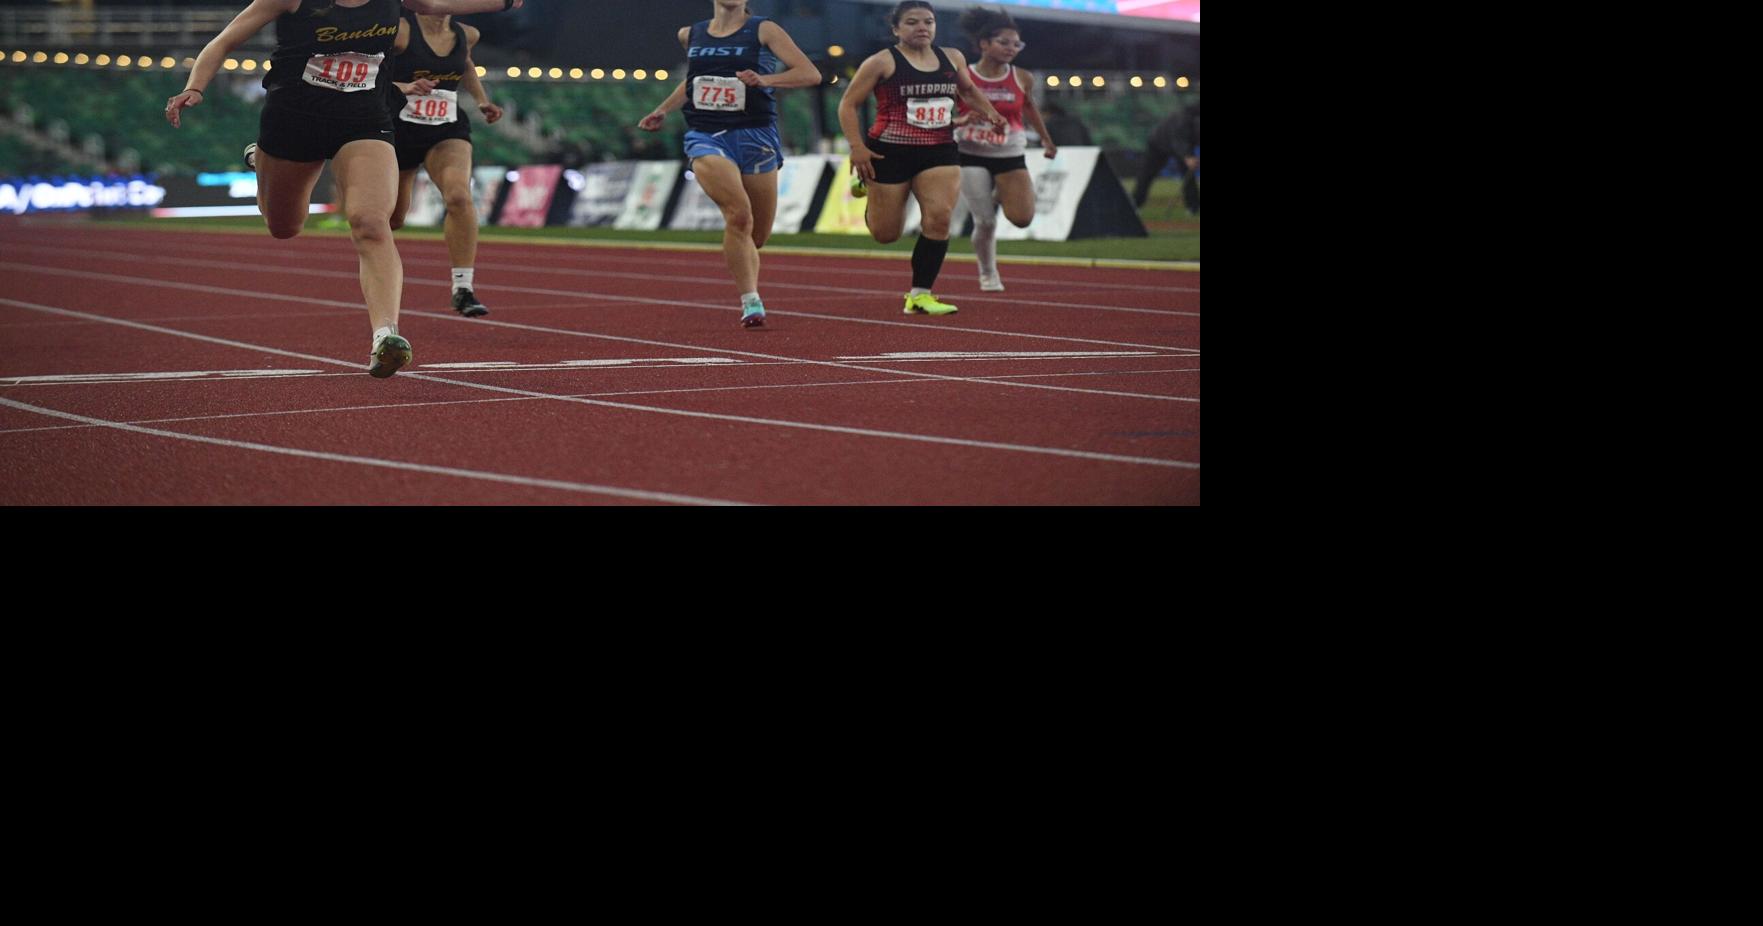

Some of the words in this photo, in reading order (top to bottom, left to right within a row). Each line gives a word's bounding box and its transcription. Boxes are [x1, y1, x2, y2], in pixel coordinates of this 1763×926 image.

[315, 24, 397, 42] Bandon
[688, 46, 747, 58] EAST
[319, 58, 368, 83] 109
[311, 75, 338, 86] TRACK
[702, 86, 736, 104] 775
[900, 83, 957, 96] ENTERPRIS
[412, 99, 448, 117] 108
[915, 106, 945, 121] 818
